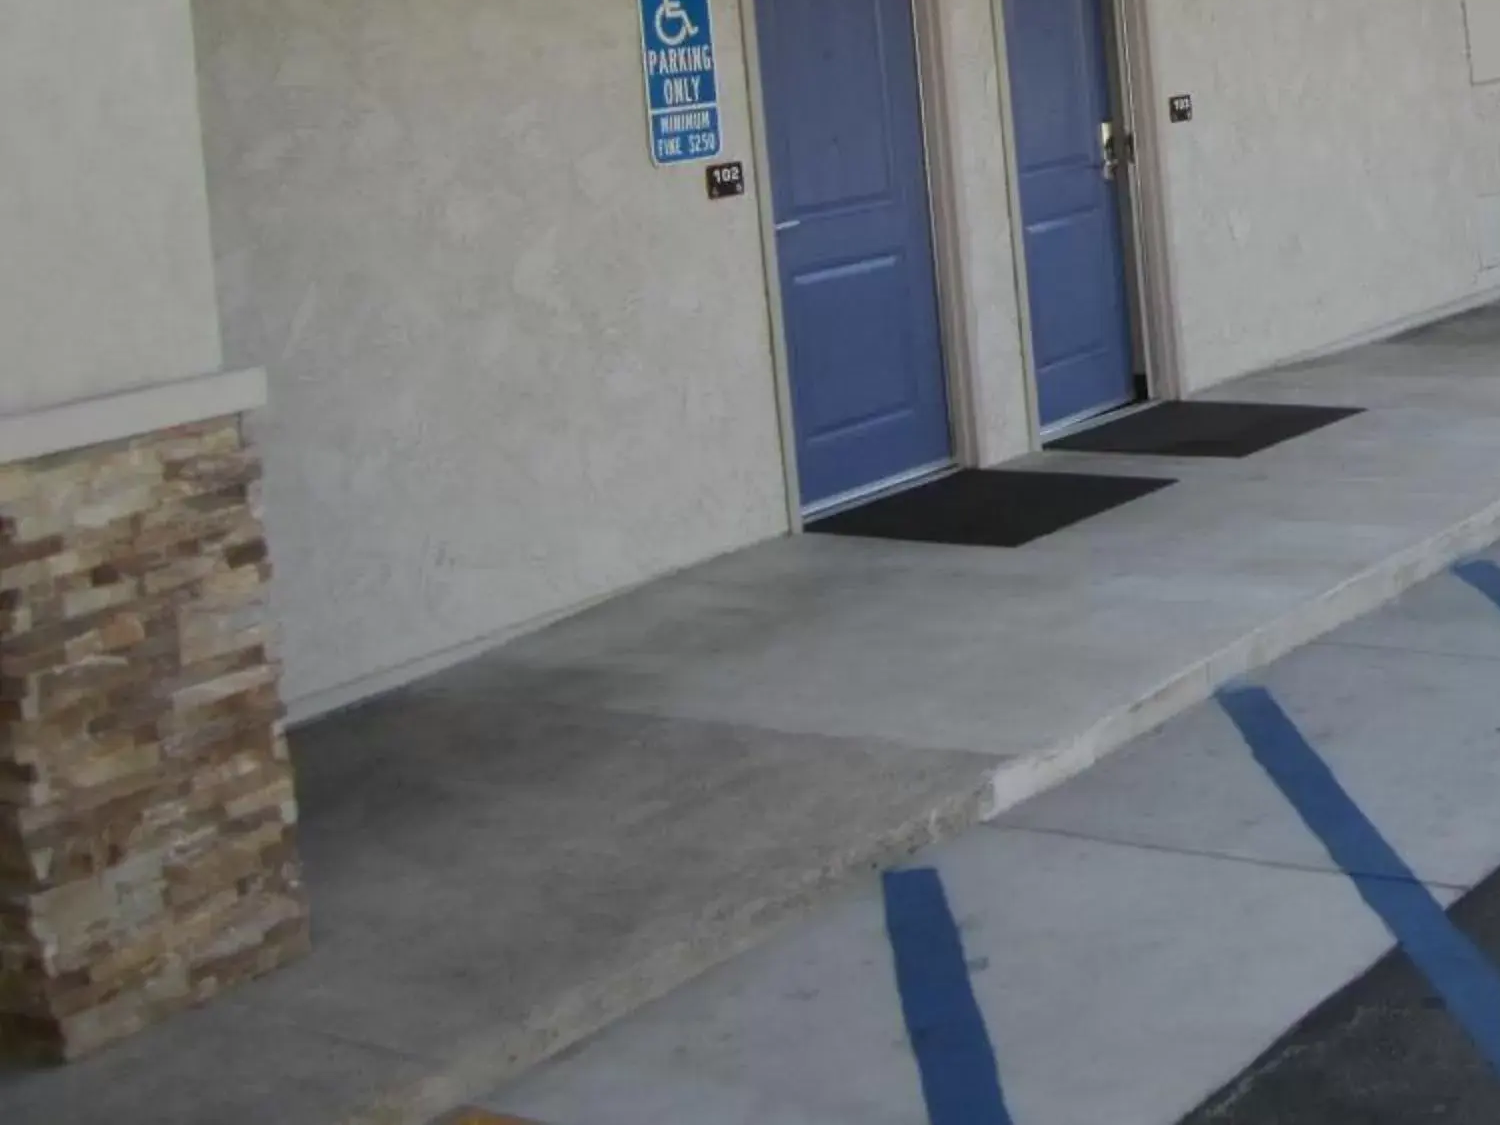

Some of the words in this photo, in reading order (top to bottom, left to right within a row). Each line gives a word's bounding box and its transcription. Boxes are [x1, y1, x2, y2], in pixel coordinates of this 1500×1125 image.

[647, 44, 711, 75] PARKING
[663, 75, 701, 105] ONLY
[660, 111, 710, 135] MINIMUM
[657, 136, 683, 156] FINE
[713, 166, 740, 184] 102
